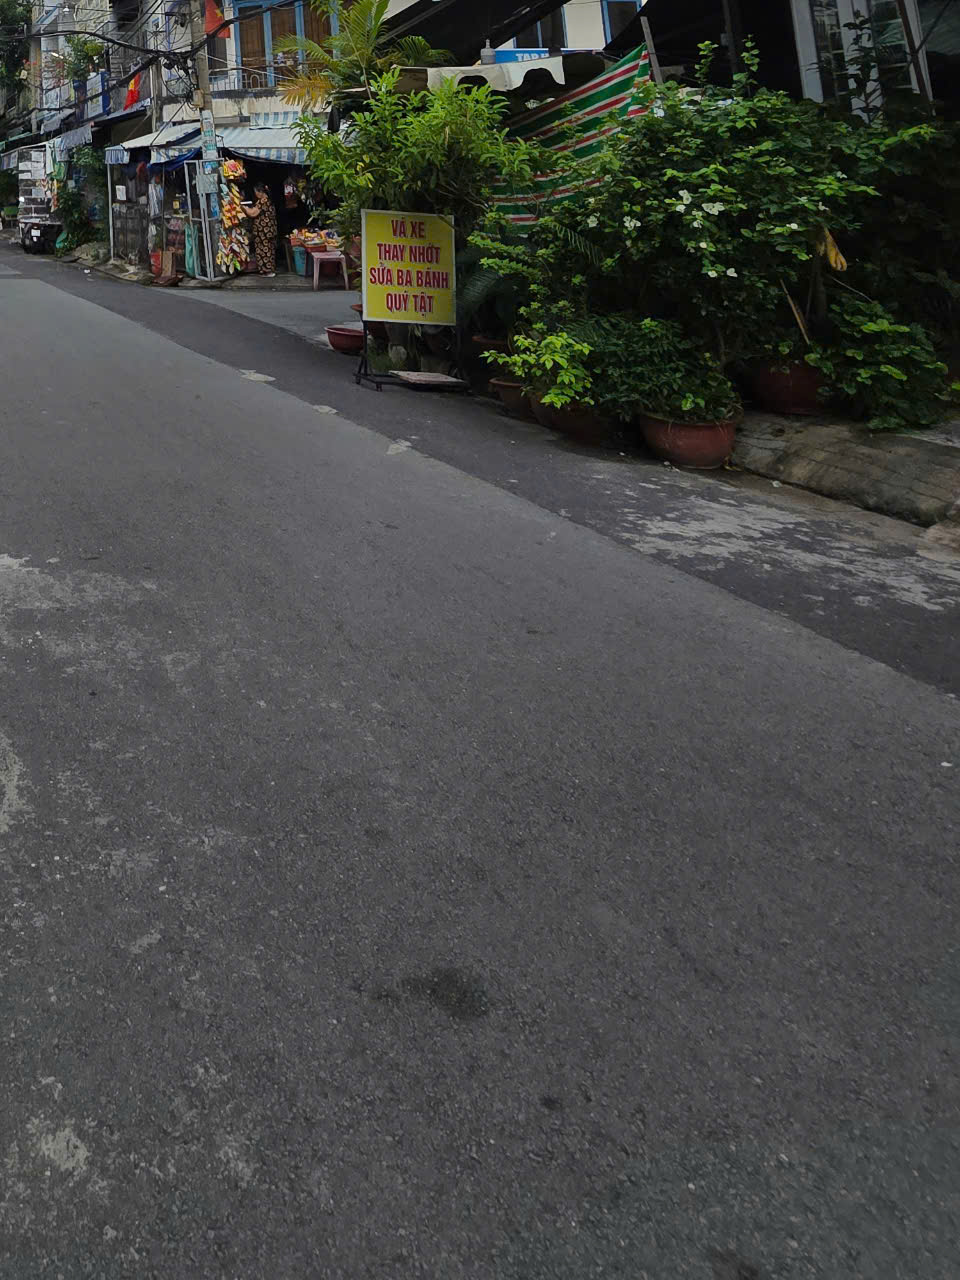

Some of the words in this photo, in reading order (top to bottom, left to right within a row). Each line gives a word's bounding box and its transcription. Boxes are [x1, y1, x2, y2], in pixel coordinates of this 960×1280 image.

[410, 221, 425, 238] XE
[377, 243, 405, 261] THAY
[409, 242, 440, 263] NHỚT
[369, 261, 393, 286] SỬA
[396, 269, 412, 286] BA
[416, 267, 448, 288] BÁNH
[386, 290, 408, 312] QUÝ
[412, 291, 433, 317] TẬT
